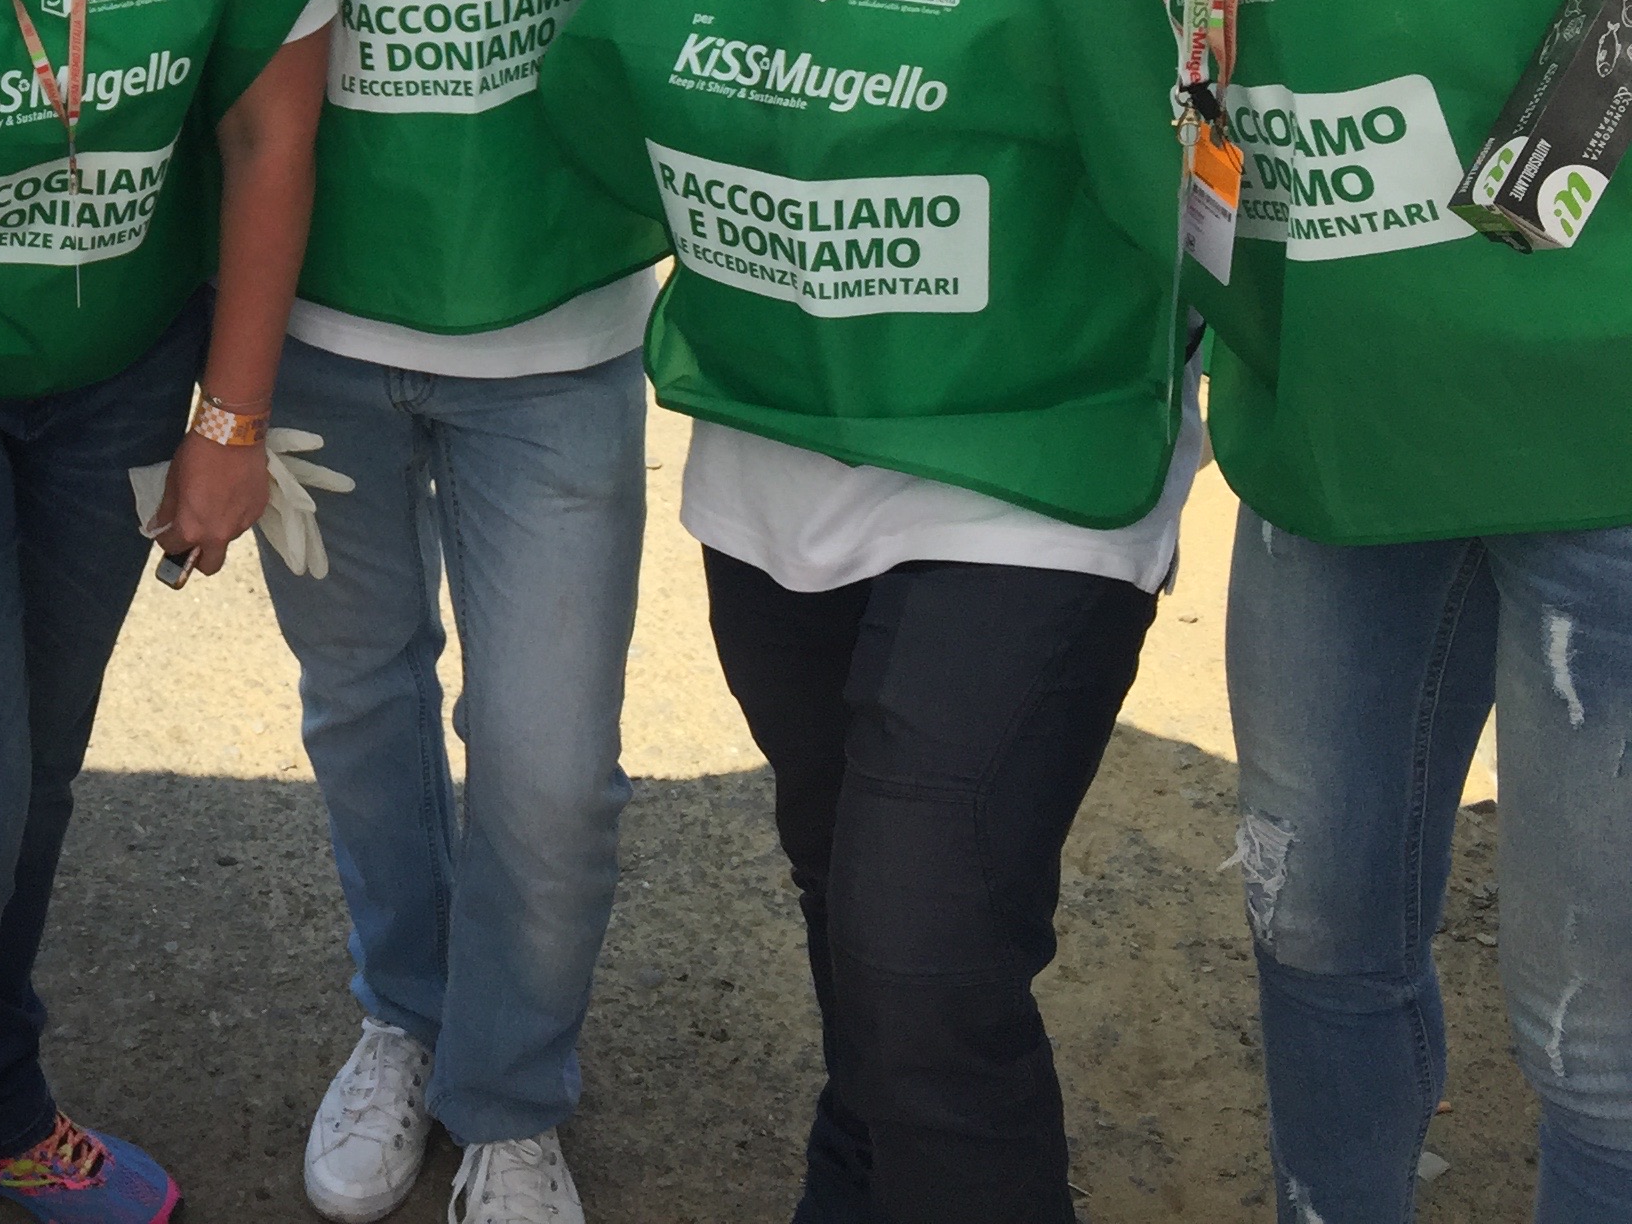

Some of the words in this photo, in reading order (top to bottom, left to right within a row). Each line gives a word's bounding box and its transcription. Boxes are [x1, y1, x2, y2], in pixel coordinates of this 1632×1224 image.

[692, 12, 716, 26] per
[359, 41, 375, 72] E
[386, 17, 556, 72] DONIAMO
[341, 74, 356, 93] LE
[359, 78, 475, 97] ECCEDENZE
[668, 74, 696, 91] Keep
[708, 82, 738, 100] Shiny
[747, 89, 808, 111] Sustainable
[5, 114, 15, 127] &
[657, 161, 961, 233] RACCOGLIAMO
[689, 208, 708, 239] E
[718, 219, 921, 273] DONIAMO
[693, 246, 798, 289] ECCEDENZE
[801, 276, 960, 301] ALIMENTARI
